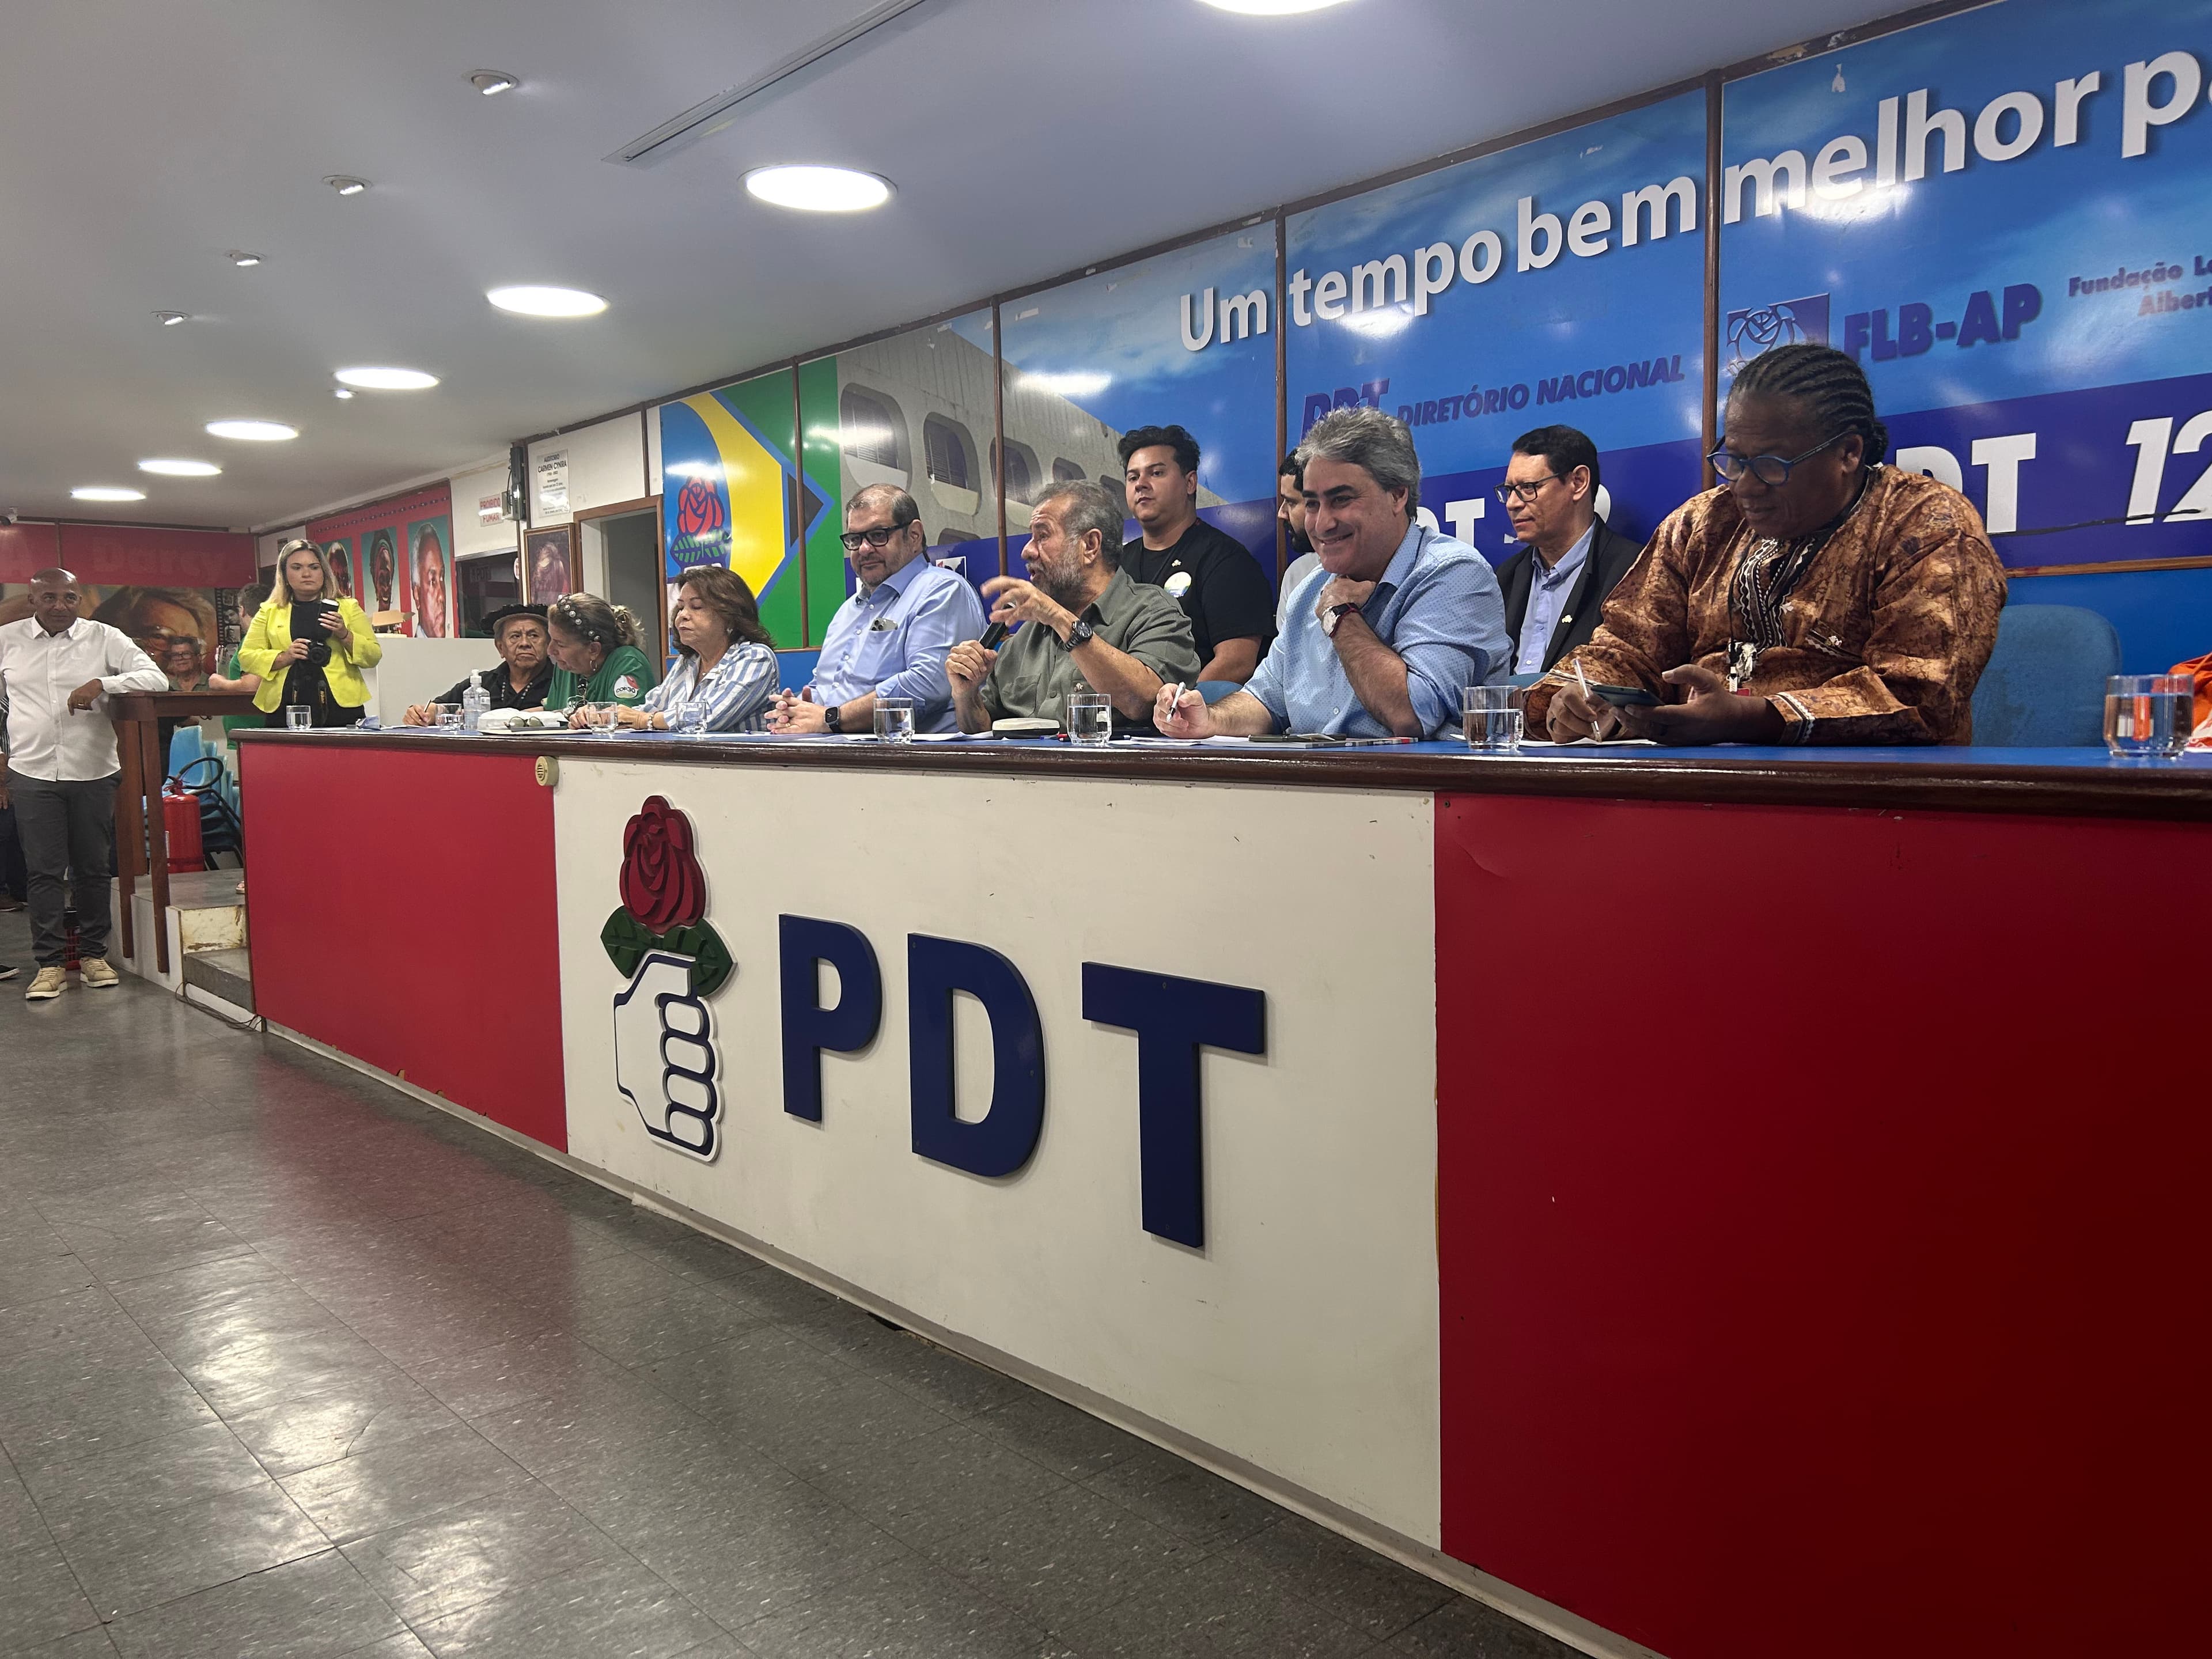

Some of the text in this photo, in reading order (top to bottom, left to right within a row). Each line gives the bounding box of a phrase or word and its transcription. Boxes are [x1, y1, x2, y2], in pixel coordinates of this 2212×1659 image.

[1180, 50, 2212, 351] Um tempo bem melhor p
[2069, 262, 2183, 297] Fundação
[1844, 283, 2042, 362] FLB-AP
[1397, 384, 1530, 426] DIRETÓRIO
[1536, 354, 1685, 406] NACIONAL
[779, 913, 1266, 1247] PDT
